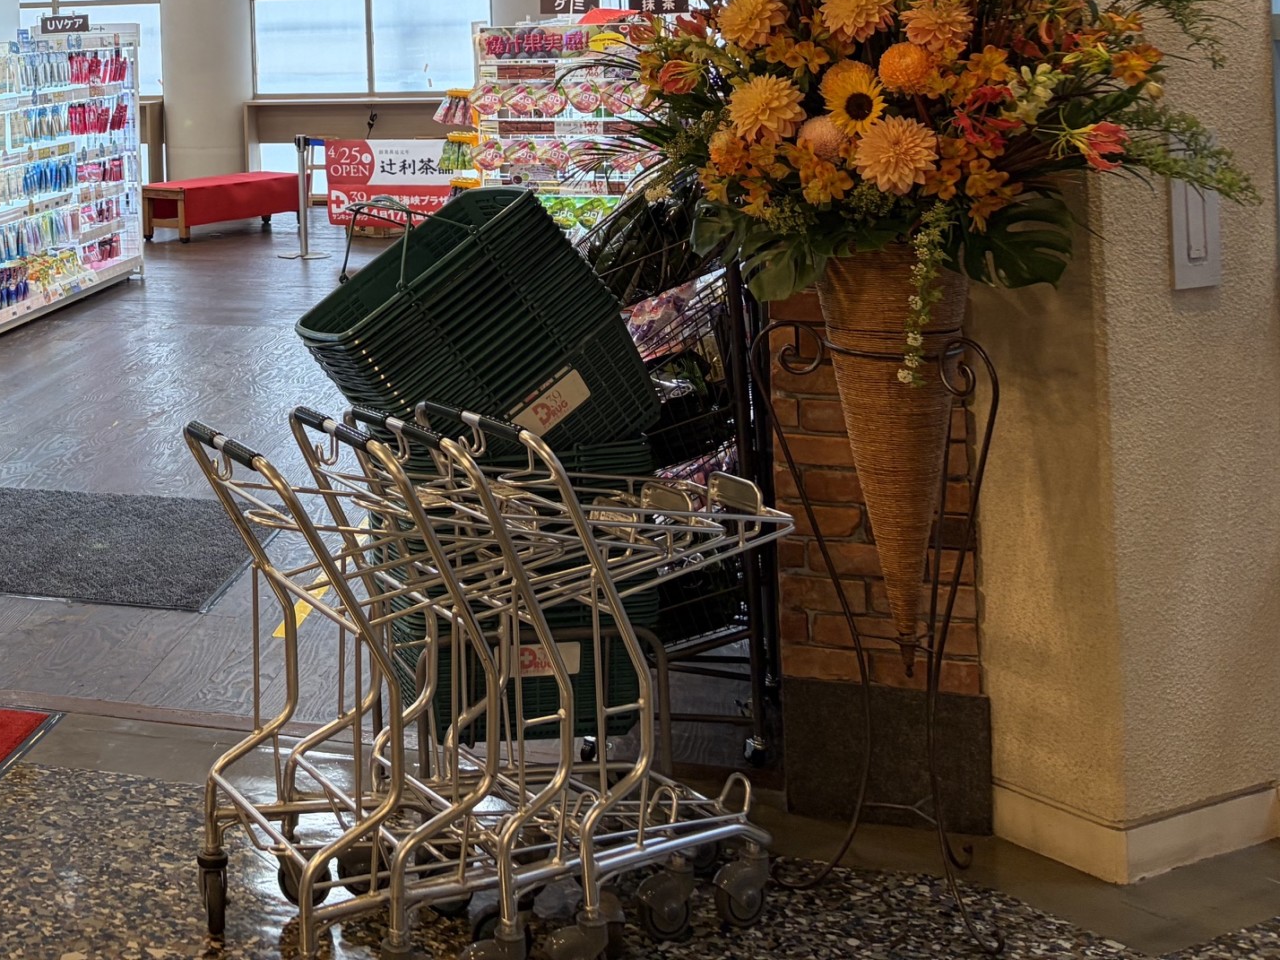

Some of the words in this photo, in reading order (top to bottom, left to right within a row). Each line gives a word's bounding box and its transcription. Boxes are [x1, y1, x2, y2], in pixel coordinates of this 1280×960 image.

[47, 18, 83, 30] UVケア
[328, 146, 360, 164] 4/25
[330, 165, 369, 177] OPEN
[349, 191, 367, 203] 39
